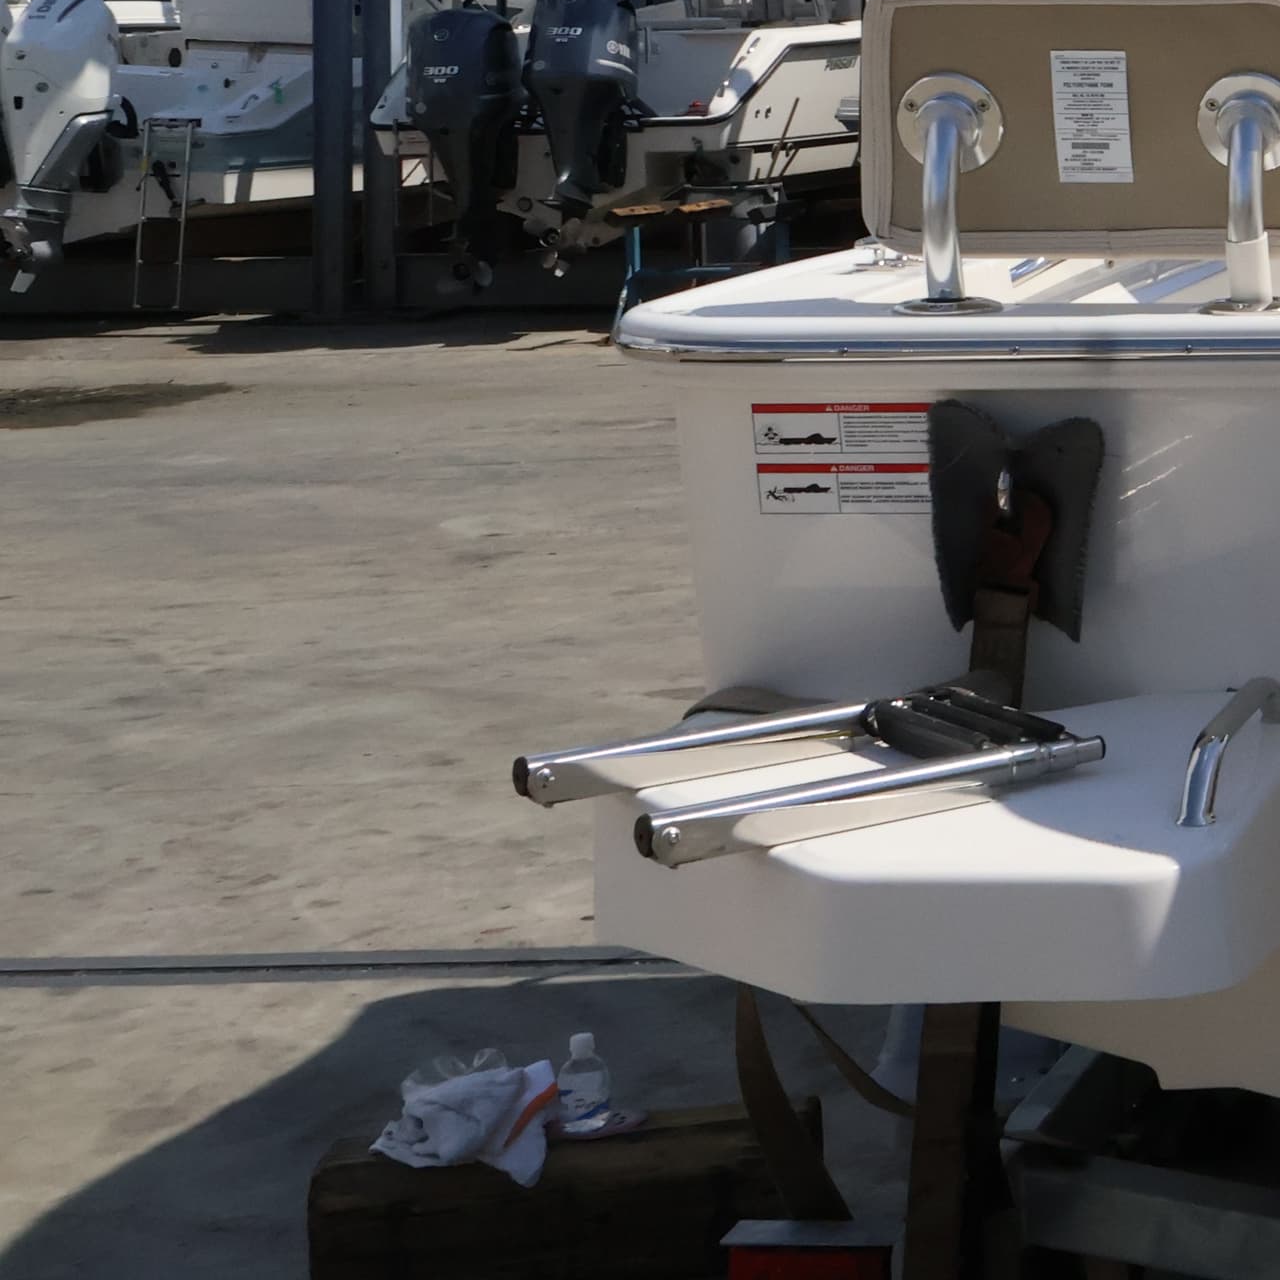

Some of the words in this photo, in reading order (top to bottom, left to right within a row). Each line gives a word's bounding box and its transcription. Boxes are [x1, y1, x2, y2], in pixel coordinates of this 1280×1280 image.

[423, 65, 459, 76] 300
[833, 404, 870, 412] DANGER
[838, 464, 875, 472] DANGER
